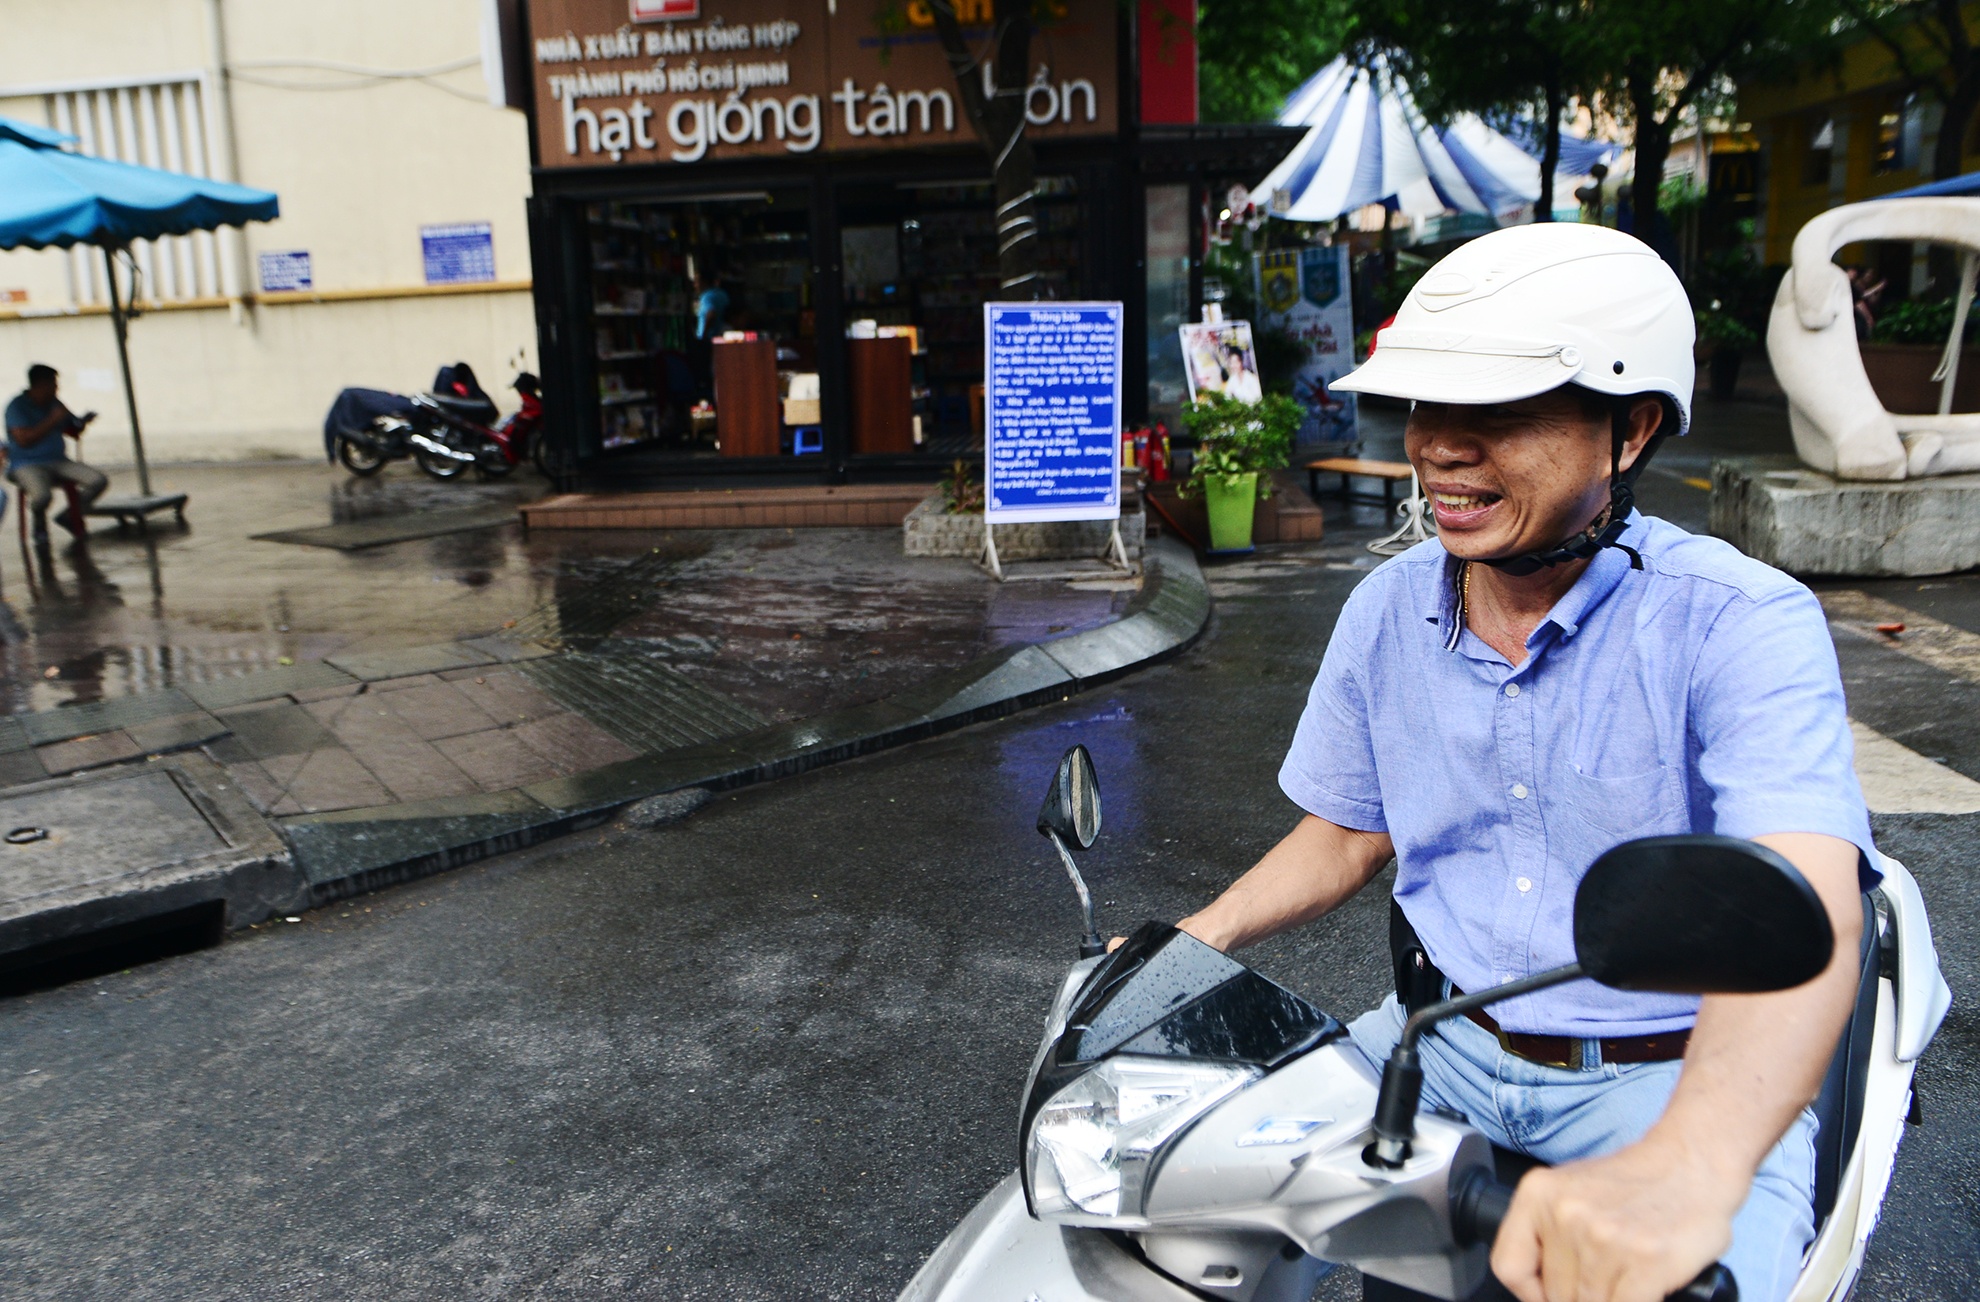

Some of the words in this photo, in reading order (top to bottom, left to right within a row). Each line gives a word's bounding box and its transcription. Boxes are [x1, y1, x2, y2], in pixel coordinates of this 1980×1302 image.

[561, 88, 657, 161] hạt
[666, 84, 822, 162] giống
[831, 78, 954, 136] tâm
